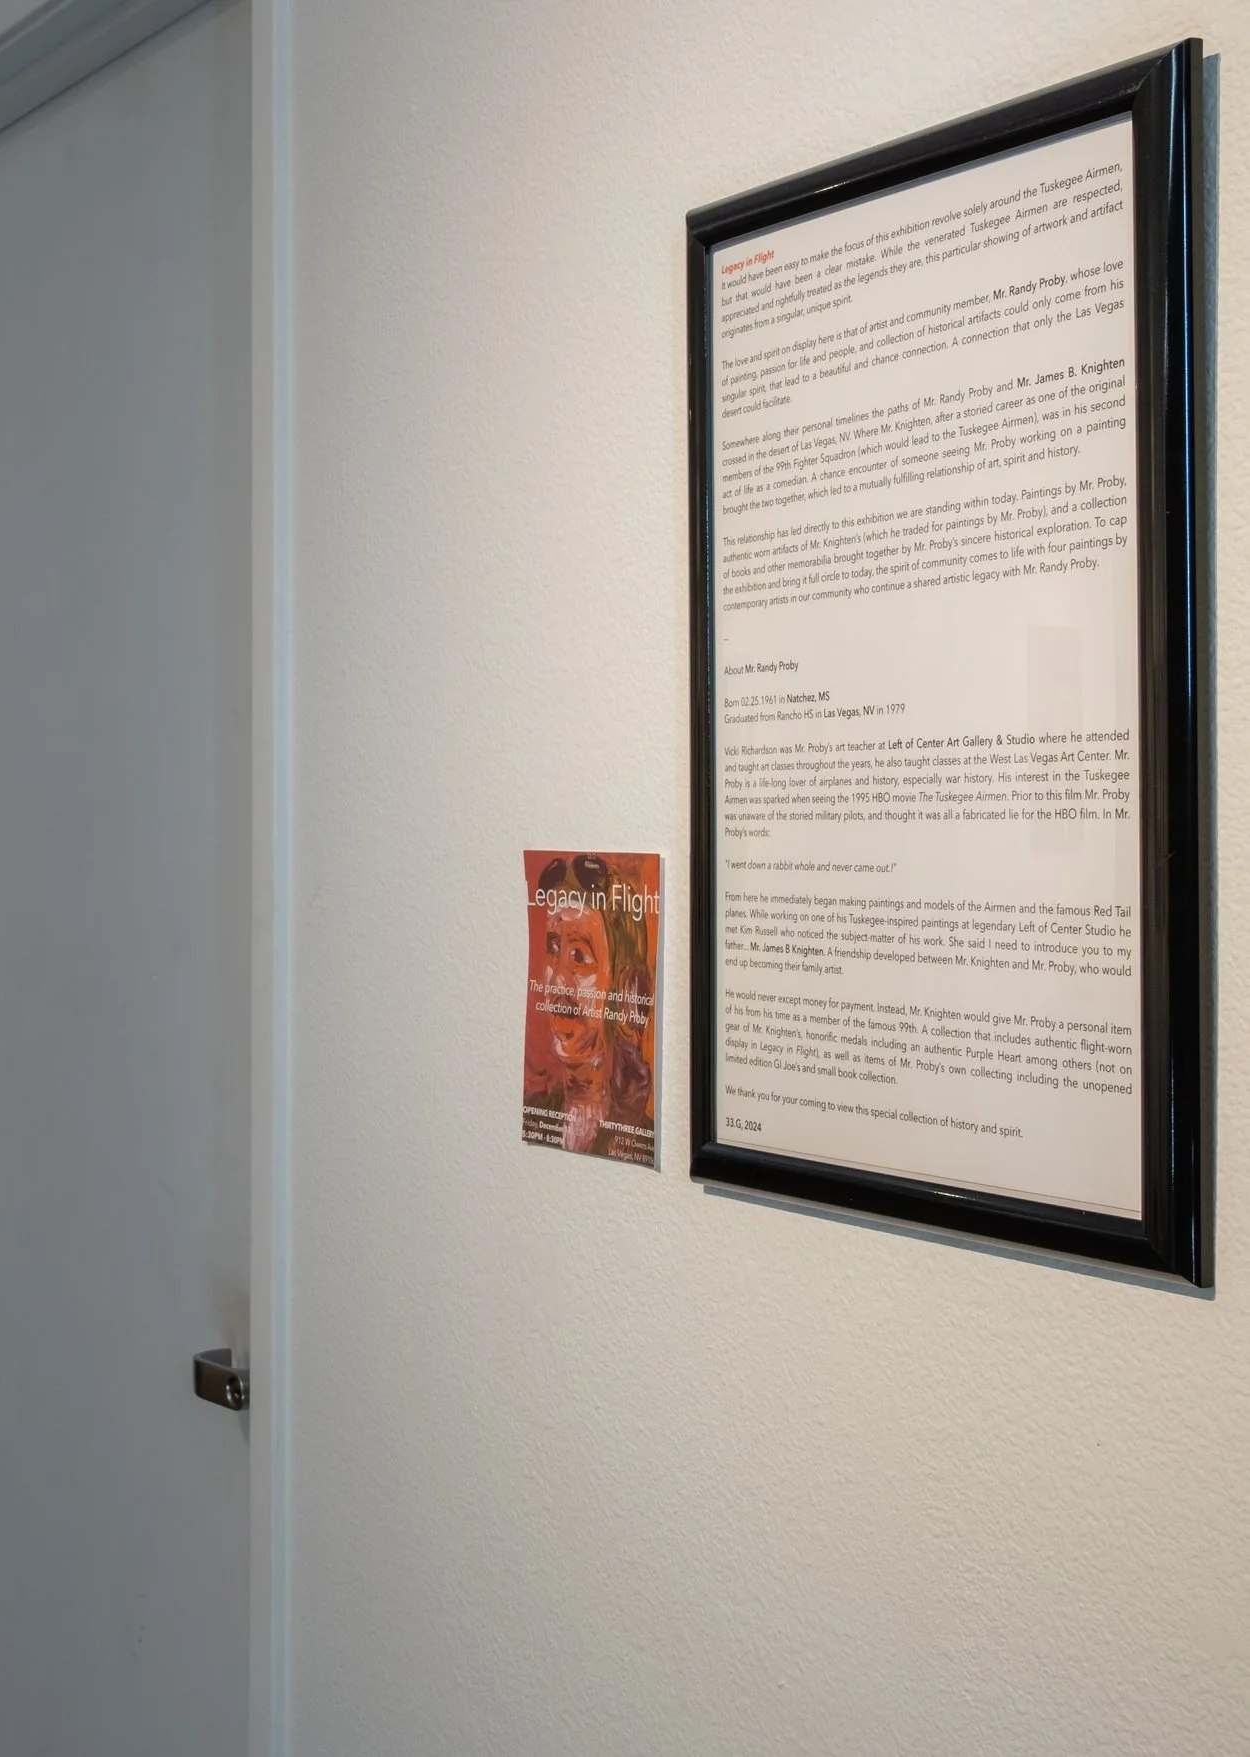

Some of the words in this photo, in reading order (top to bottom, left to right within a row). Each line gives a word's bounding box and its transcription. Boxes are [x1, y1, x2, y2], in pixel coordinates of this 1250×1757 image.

[726, 273, 747, 288] would
[747, 271, 764, 282] have
[765, 265, 783, 277] been
[783, 260, 800, 271] easy
[809, 249, 830, 263] make
[830, 245, 843, 257] the
[844, 240, 864, 252] focus
[875, 231, 889, 243] this
[890, 220, 930, 239] exhibition
[931, 210, 961, 226] revolve
[963, 201, 988, 217] solely
[989, 189, 1021, 209] around
[1022, 187, 1038, 199] the
[1039, 174, 1083, 193] Tuskegee
[1084, 163, 1122, 181] Airmen,
[721, 261, 745, 275] Legacy
[753, 250, 774, 264] Flight
[721, 359, 734, 370] The
[734, 357, 749, 367] love
[749, 350, 762, 363] and
[763, 347, 780, 361] spirit
[781, 346, 791, 355] on
[791, 338, 817, 352] display
[818, 334, 835, 344] here
[843, 327, 858, 338] that
[868, 319, 888, 332] artist
[889, 312, 905, 327] and
[906, 304, 951, 322] community
[992, 288, 1007, 301] Mr.
[1008, 280, 1037, 296] Randy
[1069, 266, 1101, 281] whose
[1103, 260, 1124, 273] love
[722, 435, 760, 450] Somewhere
[761, 431, 781, 442] along
[783, 425, 800, 437] their
[801, 417, 833, 436] personal
[835, 412, 869, 426] timelines
[871, 407, 884, 419] the
[887, 402, 909, 418] paths
[923, 396, 936, 407] Mr.
[939, 389, 965, 404] Randy
[968, 384, 993, 398] Proby
[996, 378, 1013, 393] and
[1016, 376, 1031, 389] Mr.
[1034, 371, 1064, 385] James
[1080, 358, 1125, 375] Knighten
[723, 665, 744, 675] About
[744, 663, 755, 674] Mr.
[756, 661, 778, 674] Randy
[778, 659, 799, 672] Proby
[724, 697, 740, 708] Born
[786, 692, 817, 703] Natchez,
[818, 690, 830, 701] MS
[724, 712, 759, 724] Graduated
[759, 711, 775, 722] from
[776, 709, 803, 721] Rancho
[803, 708, 814, 719] HS
[823, 708, 836, 718] Las
[836, 707, 861, 720] Vegas,
[862, 705, 875, 716] NV
[886, 703, 905, 714] 1979
[724, 746, 739, 756] Vicki
[741, 744, 777, 755] Richardson
[779, 746, 793, 754] was
[794, 743, 805, 753] Mr.
[834, 743, 845, 752] art
[847, 740, 876, 751] teacher
[887, 738, 903, 750] Left
[904, 737, 914, 749] of
[916, 737, 944, 749] Center
[946, 737, 960, 748] Art
[962, 735, 993, 749] Gallery
[1006, 733, 1036, 745] Studio
[1038, 732, 1067, 744] where
[1070, 731, 1083, 743] he
[1085, 728, 1130, 742] attended
[730, 861, 747, 869] went
[747, 859, 766, 870] down
[772, 860, 793, 871] rabbit
[793, 860, 815, 871] whole
[816, 861, 831, 872] and
[831, 864, 853, 872] never
[853, 864, 874, 873] came
[526, 879, 587, 918] Legacy
[591, 883, 607, 910] in
[612, 883, 660, 921] Flight
[530, 979, 543, 992] The
[544, 983, 575, 998] practice,
[577, 987, 607, 1001] passion
[608, 990, 623, 1001] and
[625, 991, 655, 1006] historical
[535, 1000, 572, 1014] collection
[573, 1003, 583, 1015] of
[582, 1006, 602, 1018] Artist
[604, 1008, 629, 1024] Randy
[629, 1010, 649, 1027] Proby
[523, 1105, 548, 1118] OPENING
[725, 1085, 736, 1095] We
[737, 1086, 756, 1098] thank
[756, 1092, 770, 1102] you
[770, 1091, 781, 1102] for
[781, 1095, 798, 1106] your
[798, 1098, 826, 1112] coming
[836, 1104, 854, 1113] view
[855, 1103, 869, 1116] this
[870, 1108, 898, 1120] special
[899, 1111, 938, 1125] collection
[939, 1115, 949, 1127] of
[950, 1117, 979, 1134] history
[980, 1123, 997, 1134] and
[599, 1120, 634, 1134] THIRTYTHREE
[744, 1119, 762, 1132] 2024
[614, 1135, 625, 1145] 912
